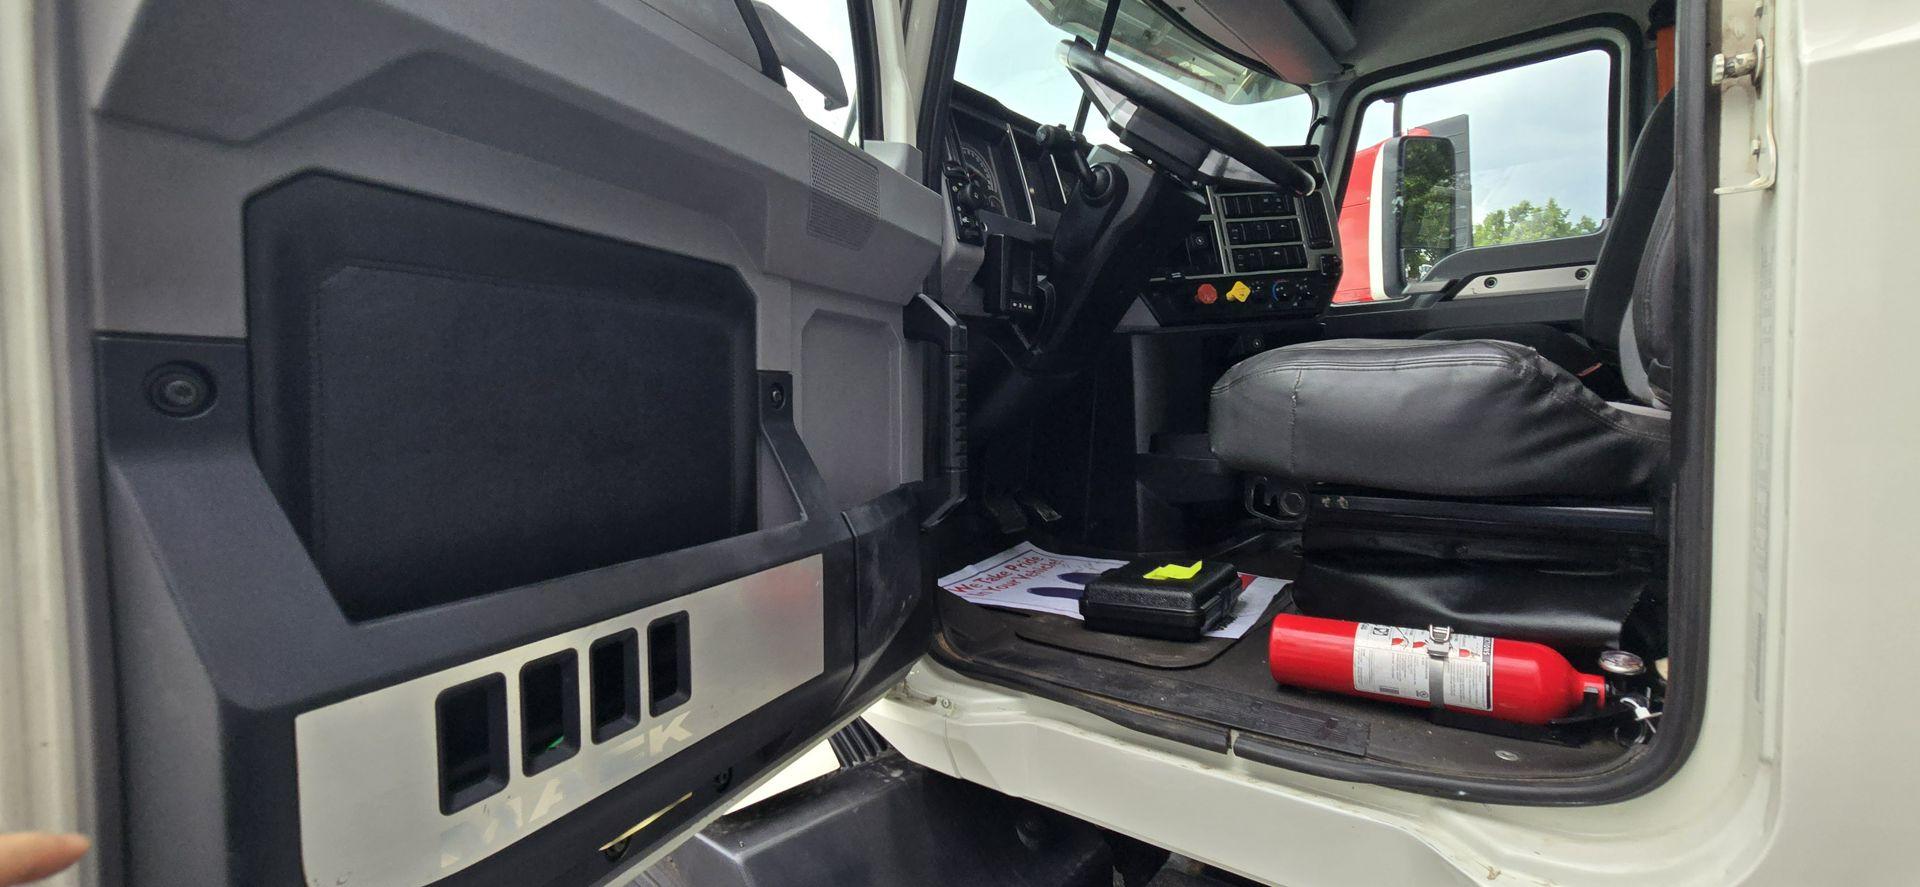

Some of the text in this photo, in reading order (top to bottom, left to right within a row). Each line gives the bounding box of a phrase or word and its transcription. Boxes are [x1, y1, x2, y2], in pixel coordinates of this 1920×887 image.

[949, 556, 1041, 593] We Take Pride
[983, 579, 1019, 592] Your
